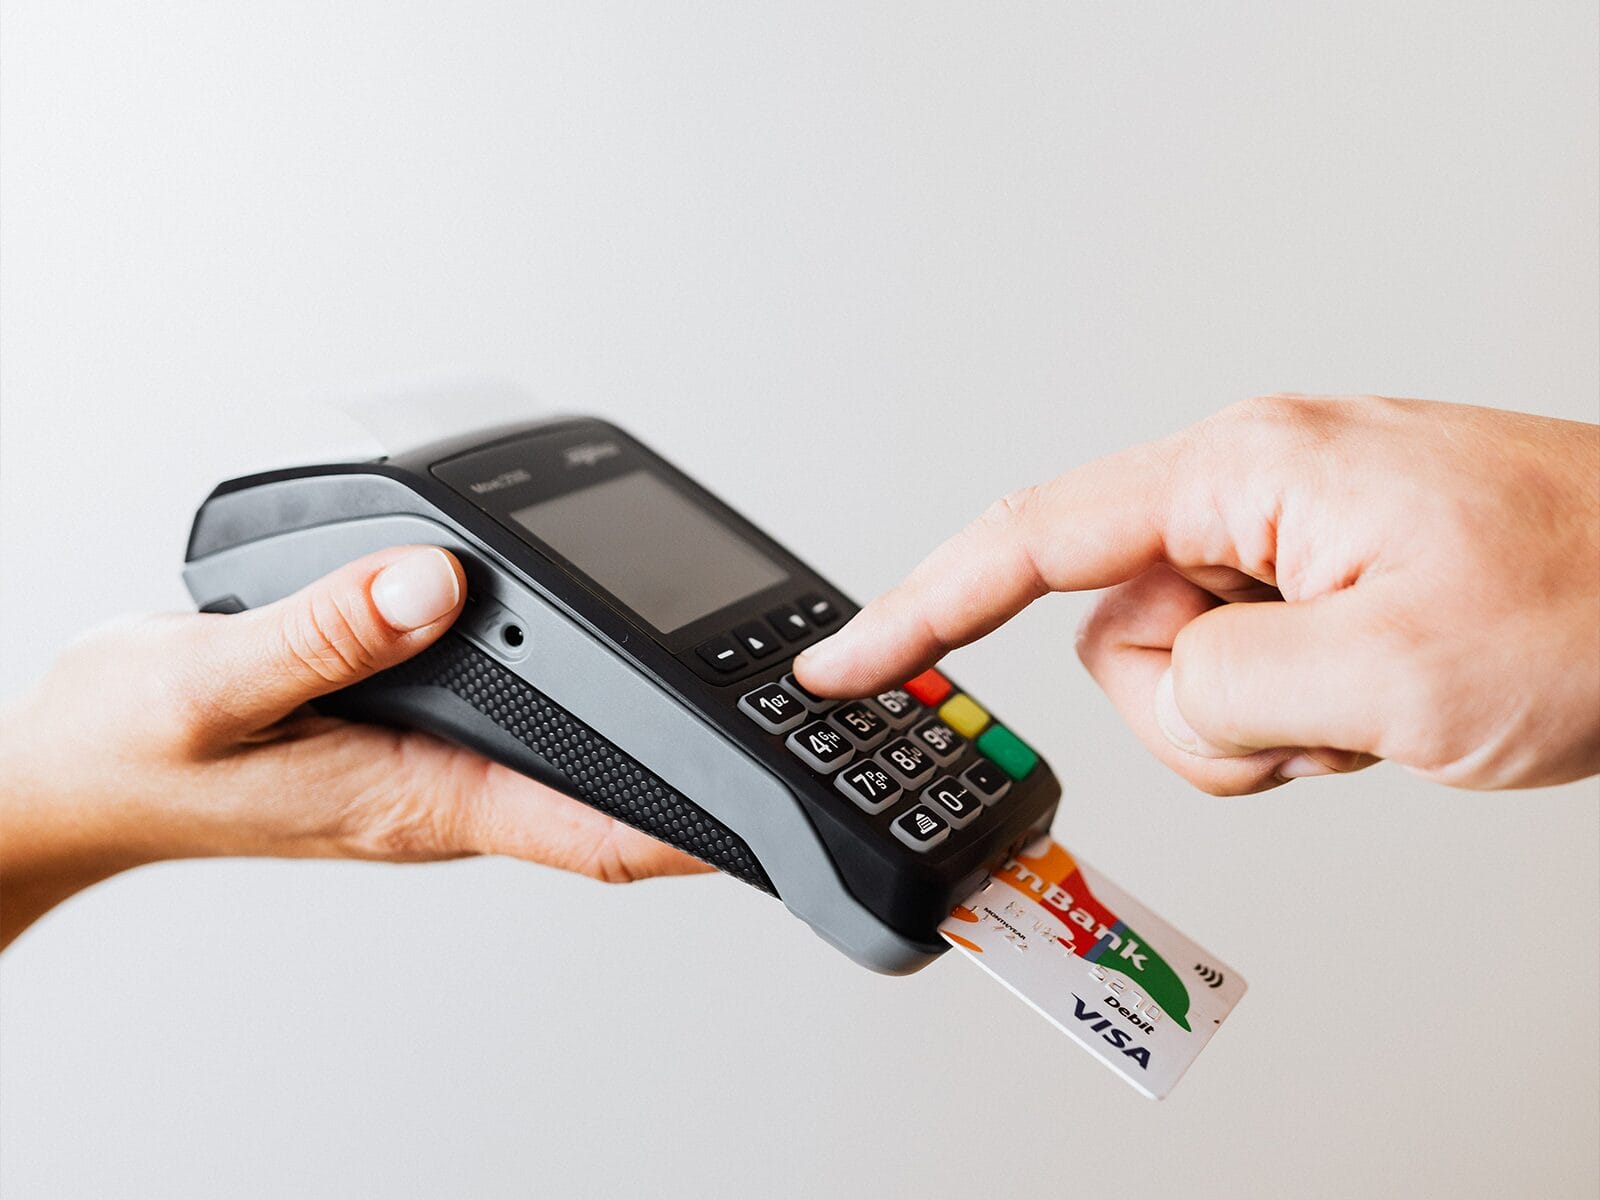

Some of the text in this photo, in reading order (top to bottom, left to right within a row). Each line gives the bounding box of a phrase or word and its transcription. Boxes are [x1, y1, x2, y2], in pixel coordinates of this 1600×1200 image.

[760, 697, 782, 715] 1
[877, 694, 902, 712] 6
[845, 713, 871, 732] 5
[809, 734, 832, 753] 4
[923, 730, 947, 750] 9
[891, 750, 916, 770] 8
[852, 773, 876, 796] 7
[1004, 860, 1149, 971] mBank
[1103, 995, 1155, 1035] Debit
[1070, 991, 1151, 1070] VISA
